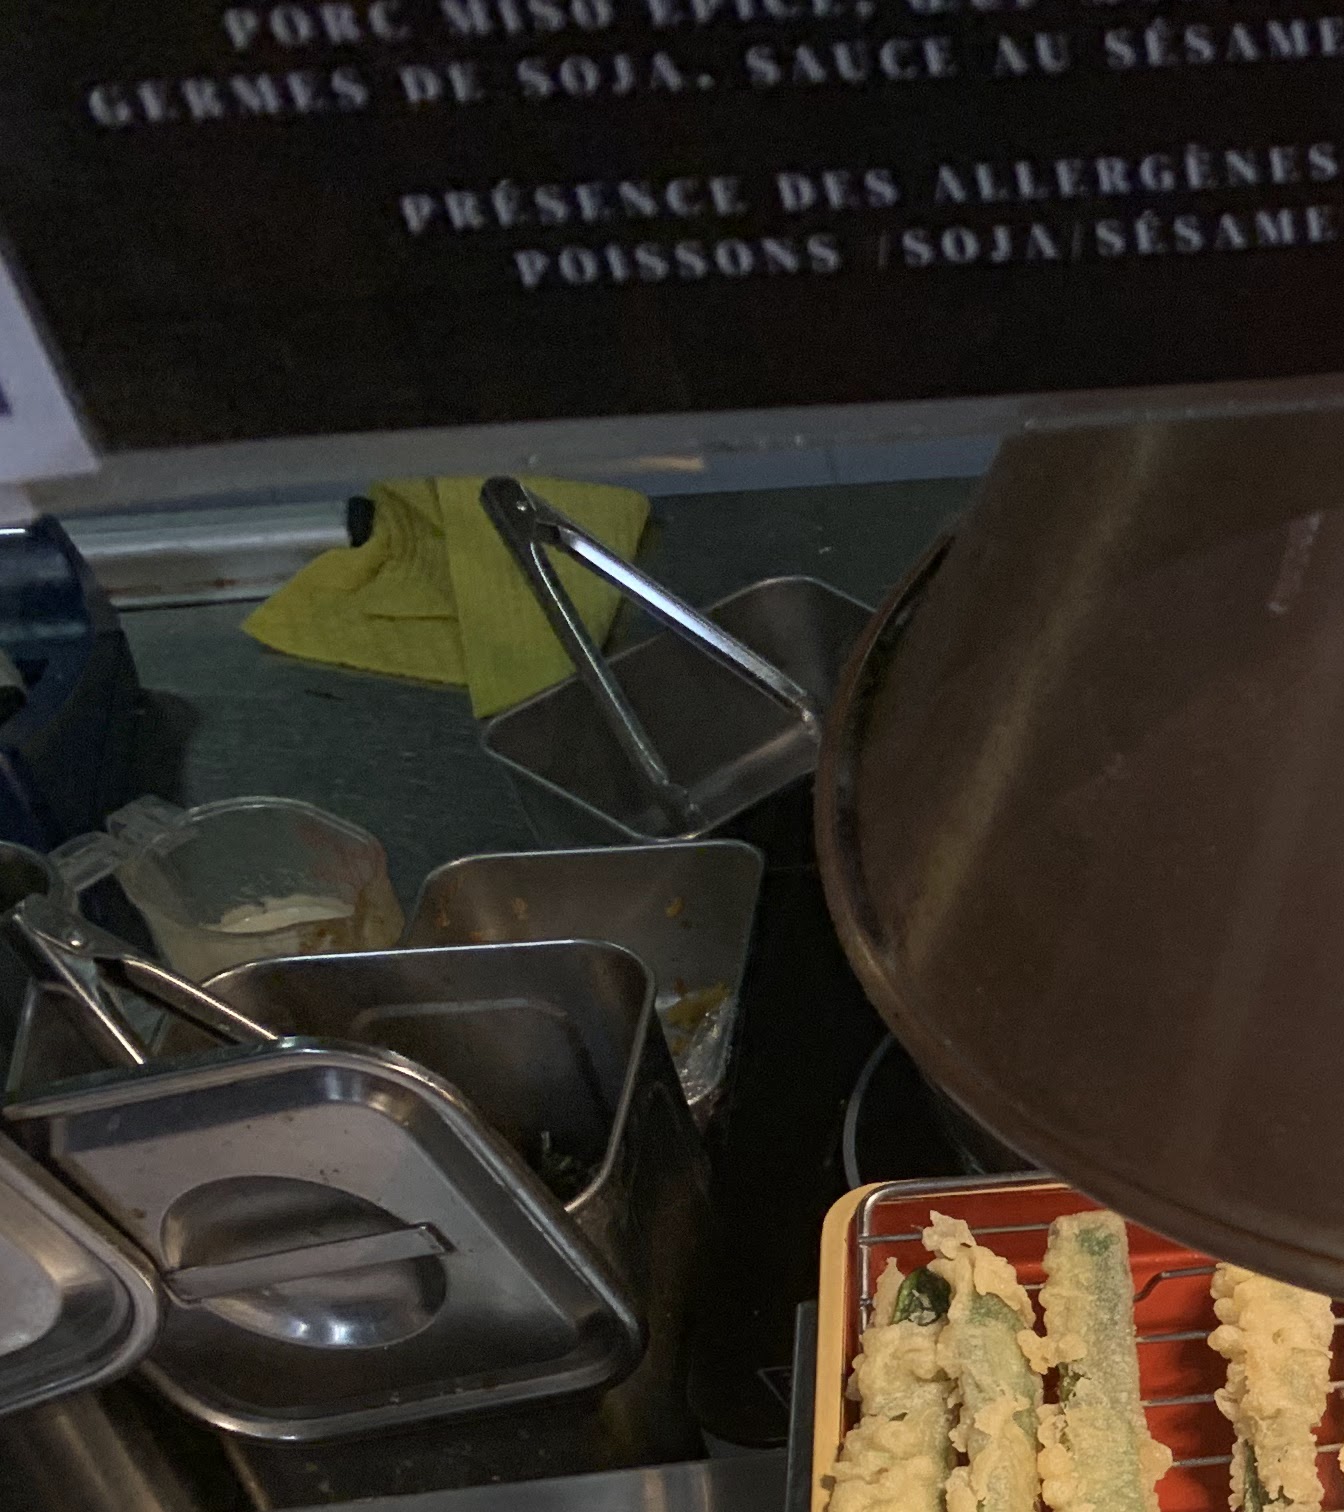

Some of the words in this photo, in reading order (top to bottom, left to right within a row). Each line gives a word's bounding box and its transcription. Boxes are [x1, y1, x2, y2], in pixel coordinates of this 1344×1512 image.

[225, 0, 404, 49] PORC
[441, 0, 613, 34] MISO
[88, 66, 368, 127] GERMES
[399, 61, 485, 104] DE
[744, 37, 957, 87] SAUCE
[994, 32, 1071, 77] AU
[399, 175, 750, 236] PRÉSENCE
[775, 167, 898, 213] DES
[514, 230, 842, 289] POISSONS
